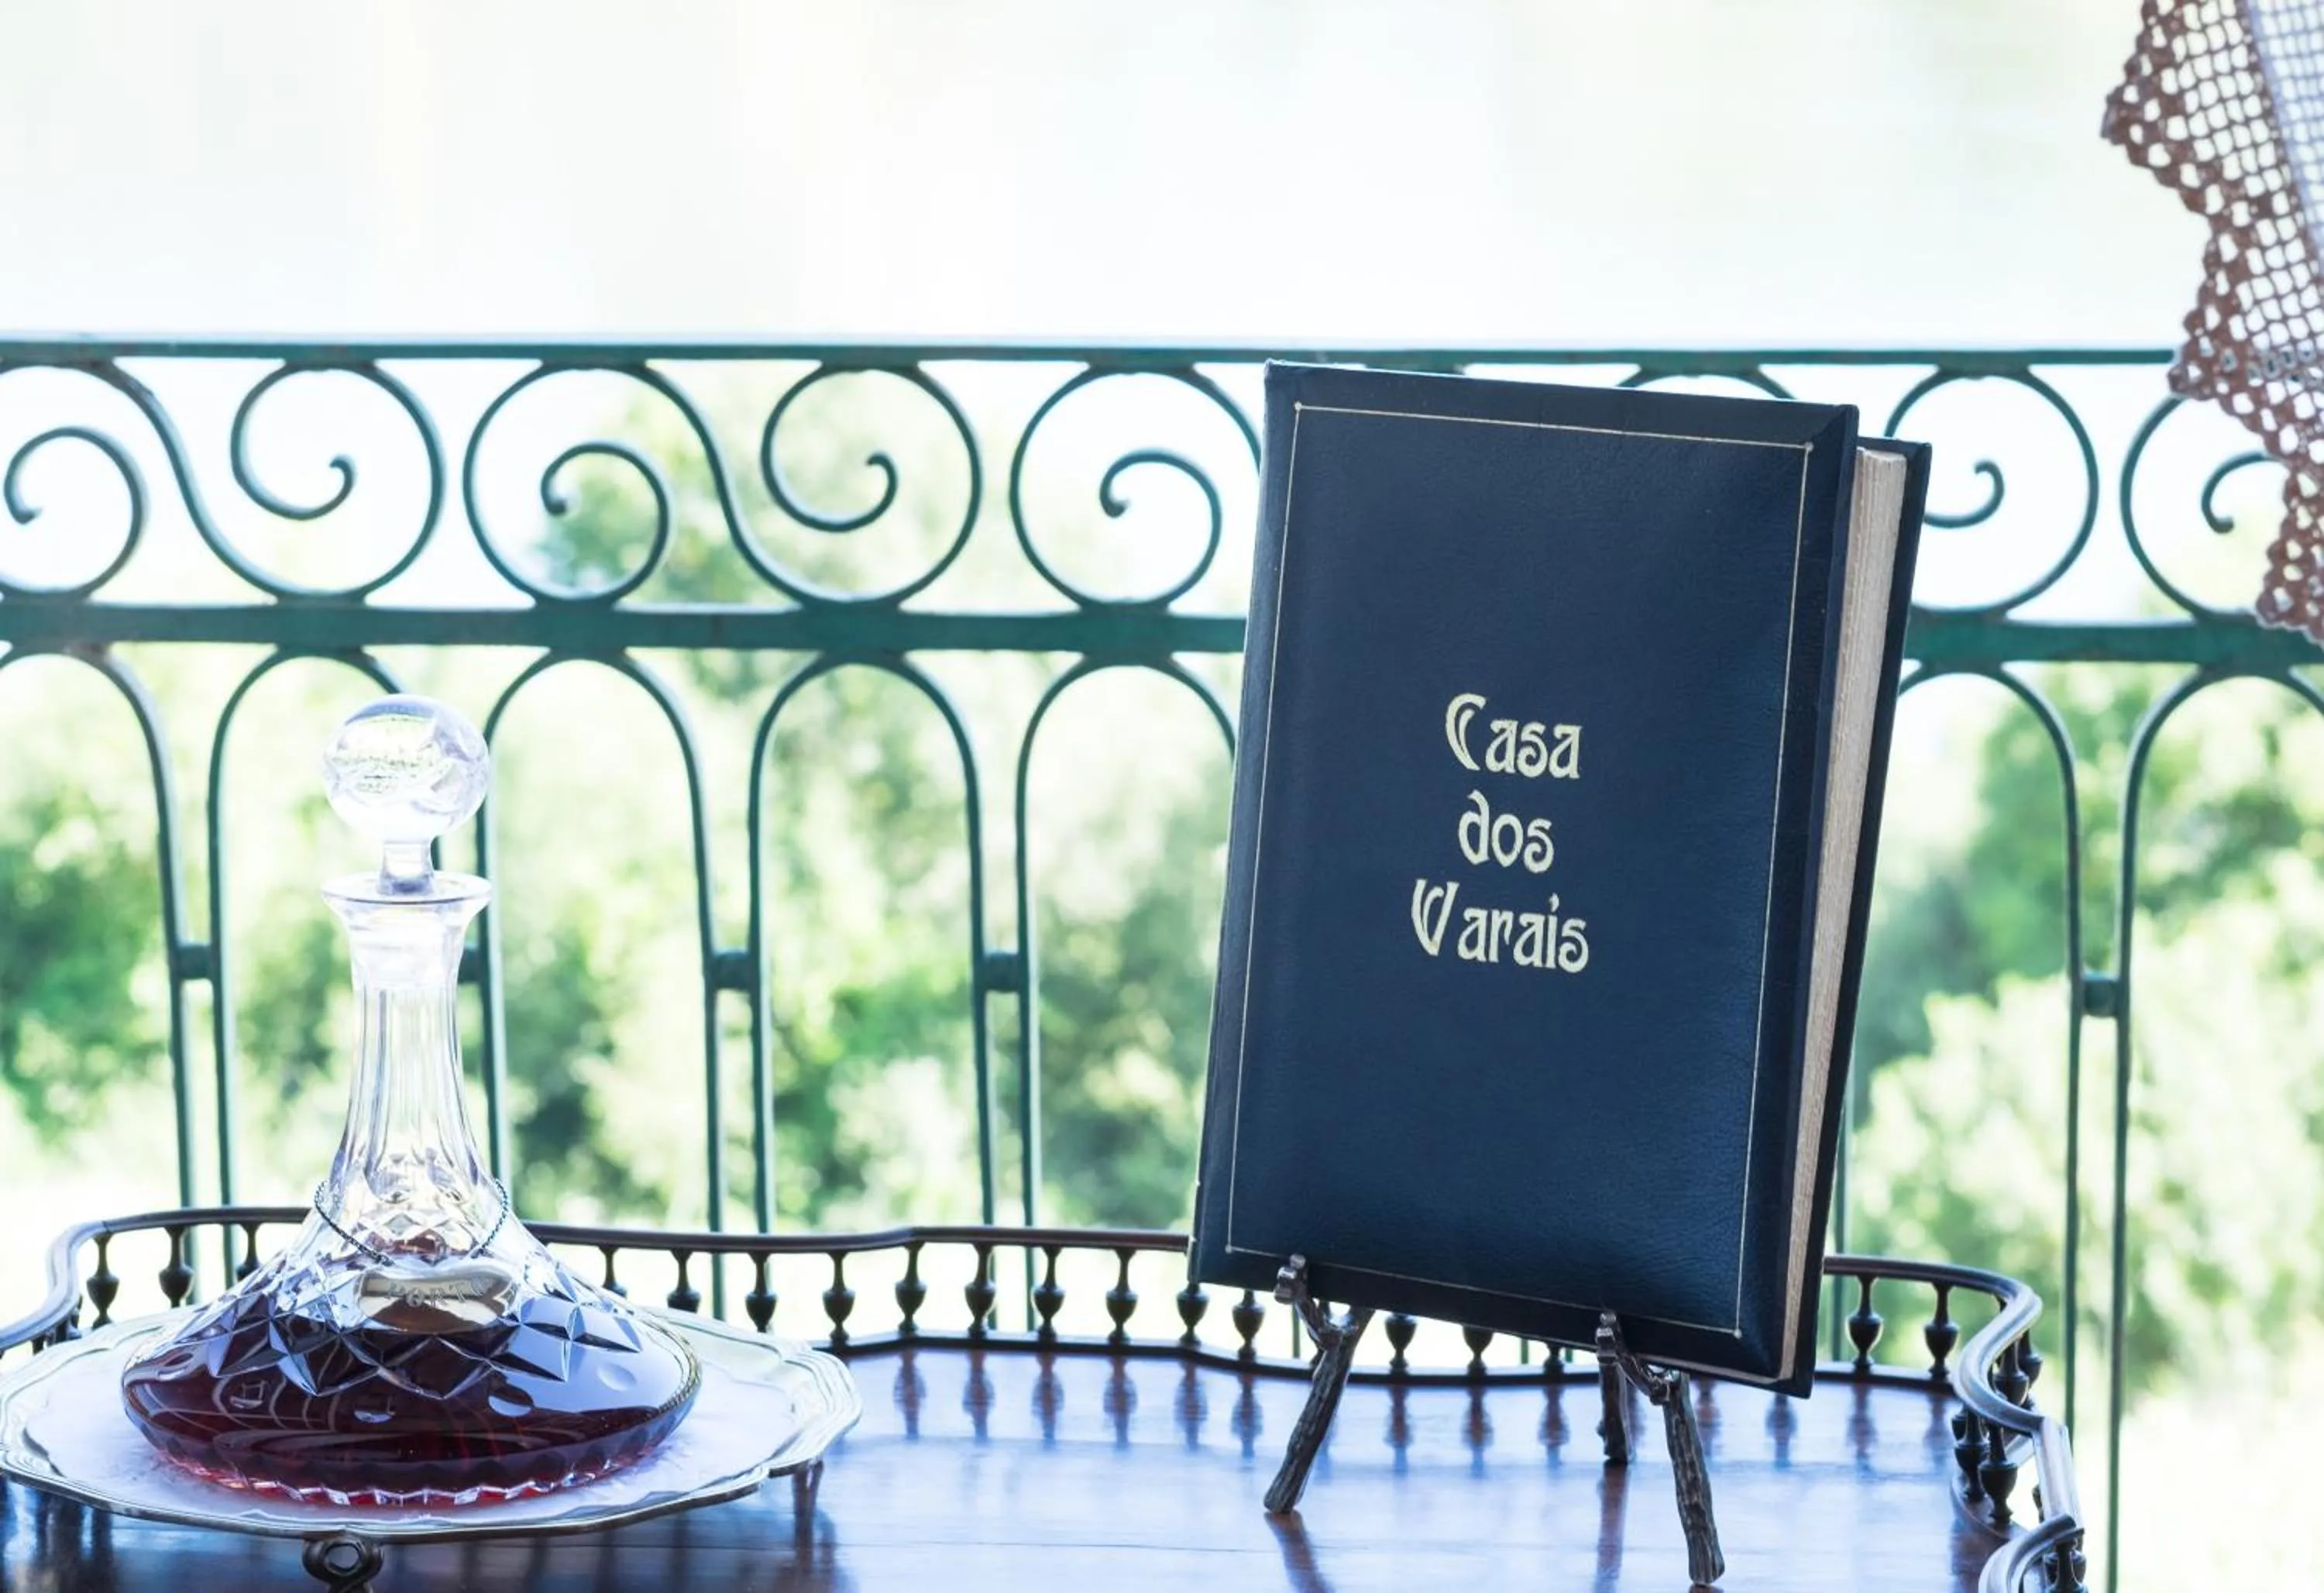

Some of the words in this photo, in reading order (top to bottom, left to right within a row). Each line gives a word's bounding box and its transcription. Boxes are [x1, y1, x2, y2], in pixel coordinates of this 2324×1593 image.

[1445, 693, 1582, 779] Casa
[1458, 790, 1555, 874] dos
[1411, 879, 1589, 973] Varais
